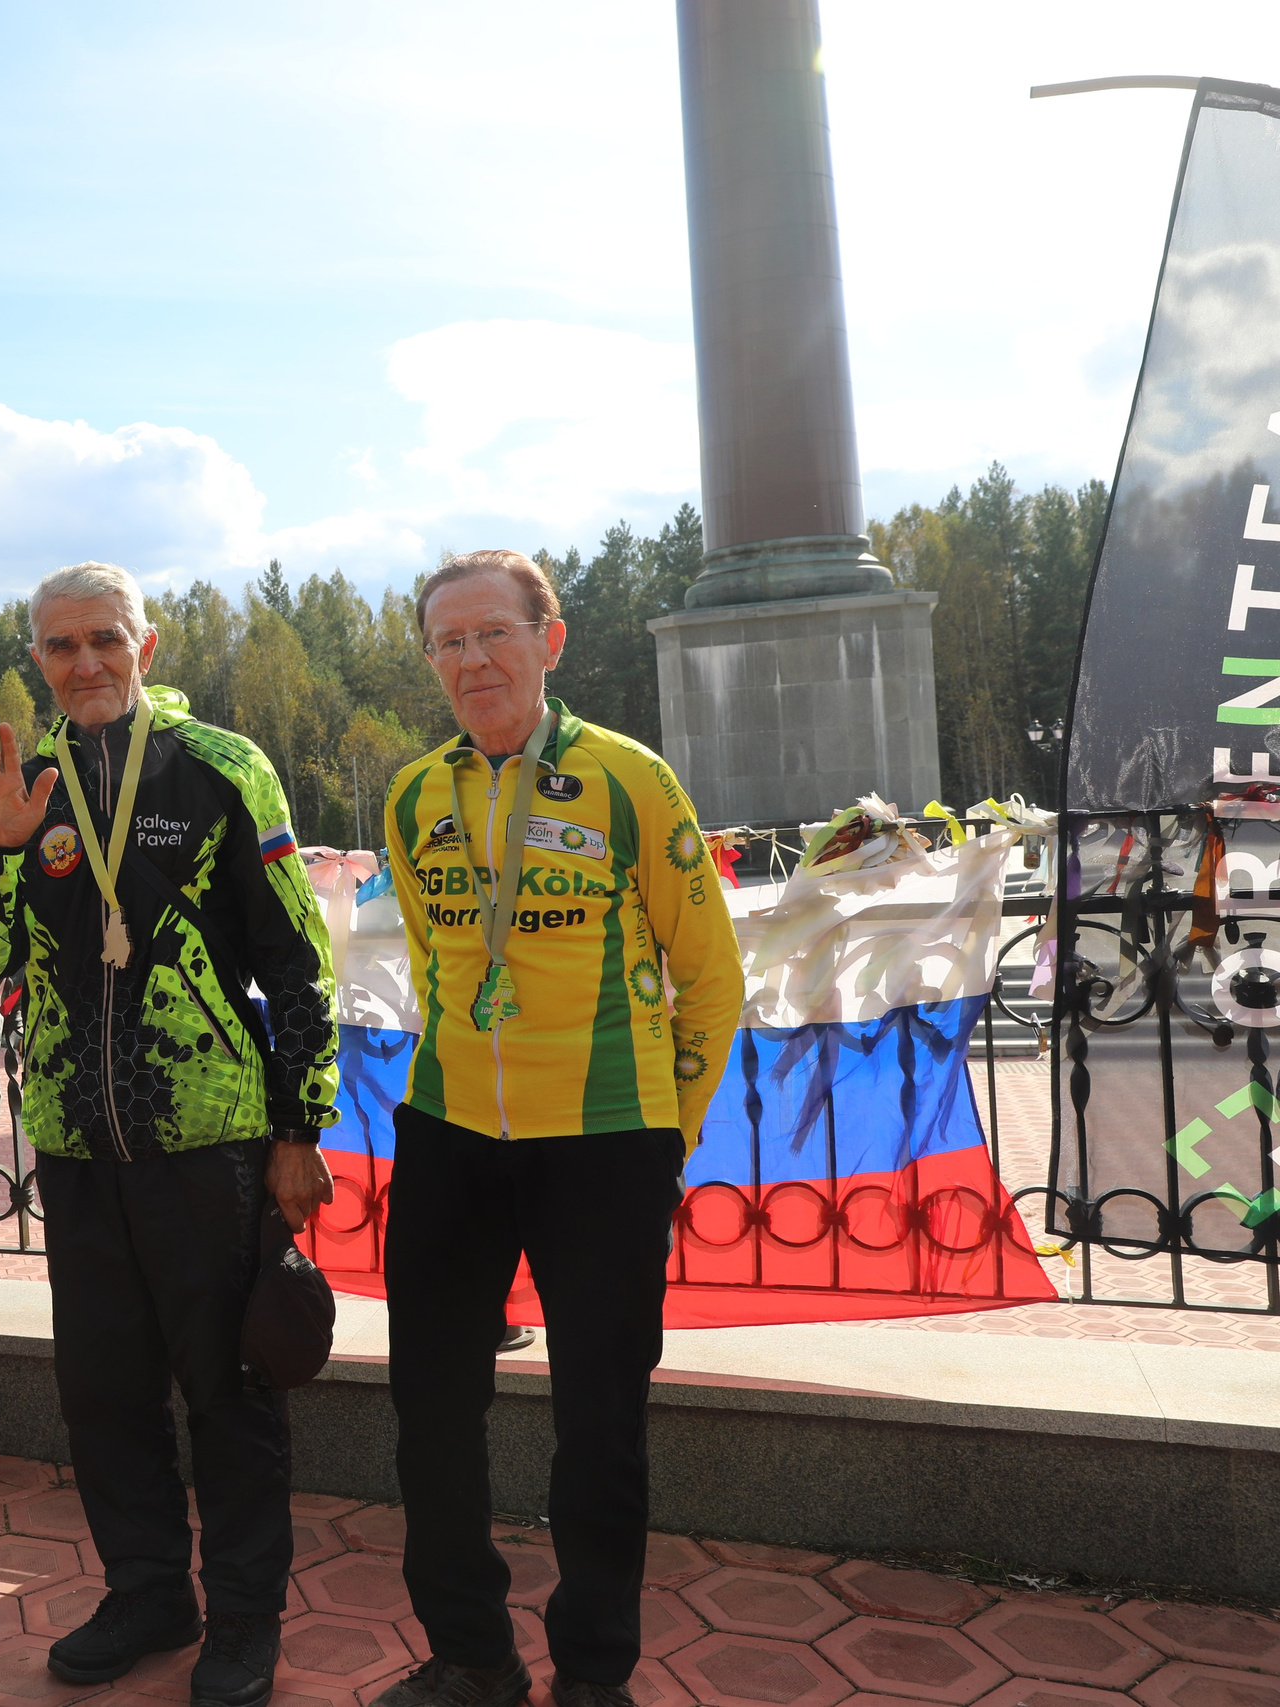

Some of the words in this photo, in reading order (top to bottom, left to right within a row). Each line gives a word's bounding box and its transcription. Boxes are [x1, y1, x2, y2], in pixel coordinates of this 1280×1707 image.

[135, 813, 191, 832] Salaev
[137, 832, 182, 847] Pavel
[527, 825, 553, 839] Köln
[589, 837, 604, 850] bp
[687, 874, 707, 906] bp
[648, 1012, 663, 1039] bp
